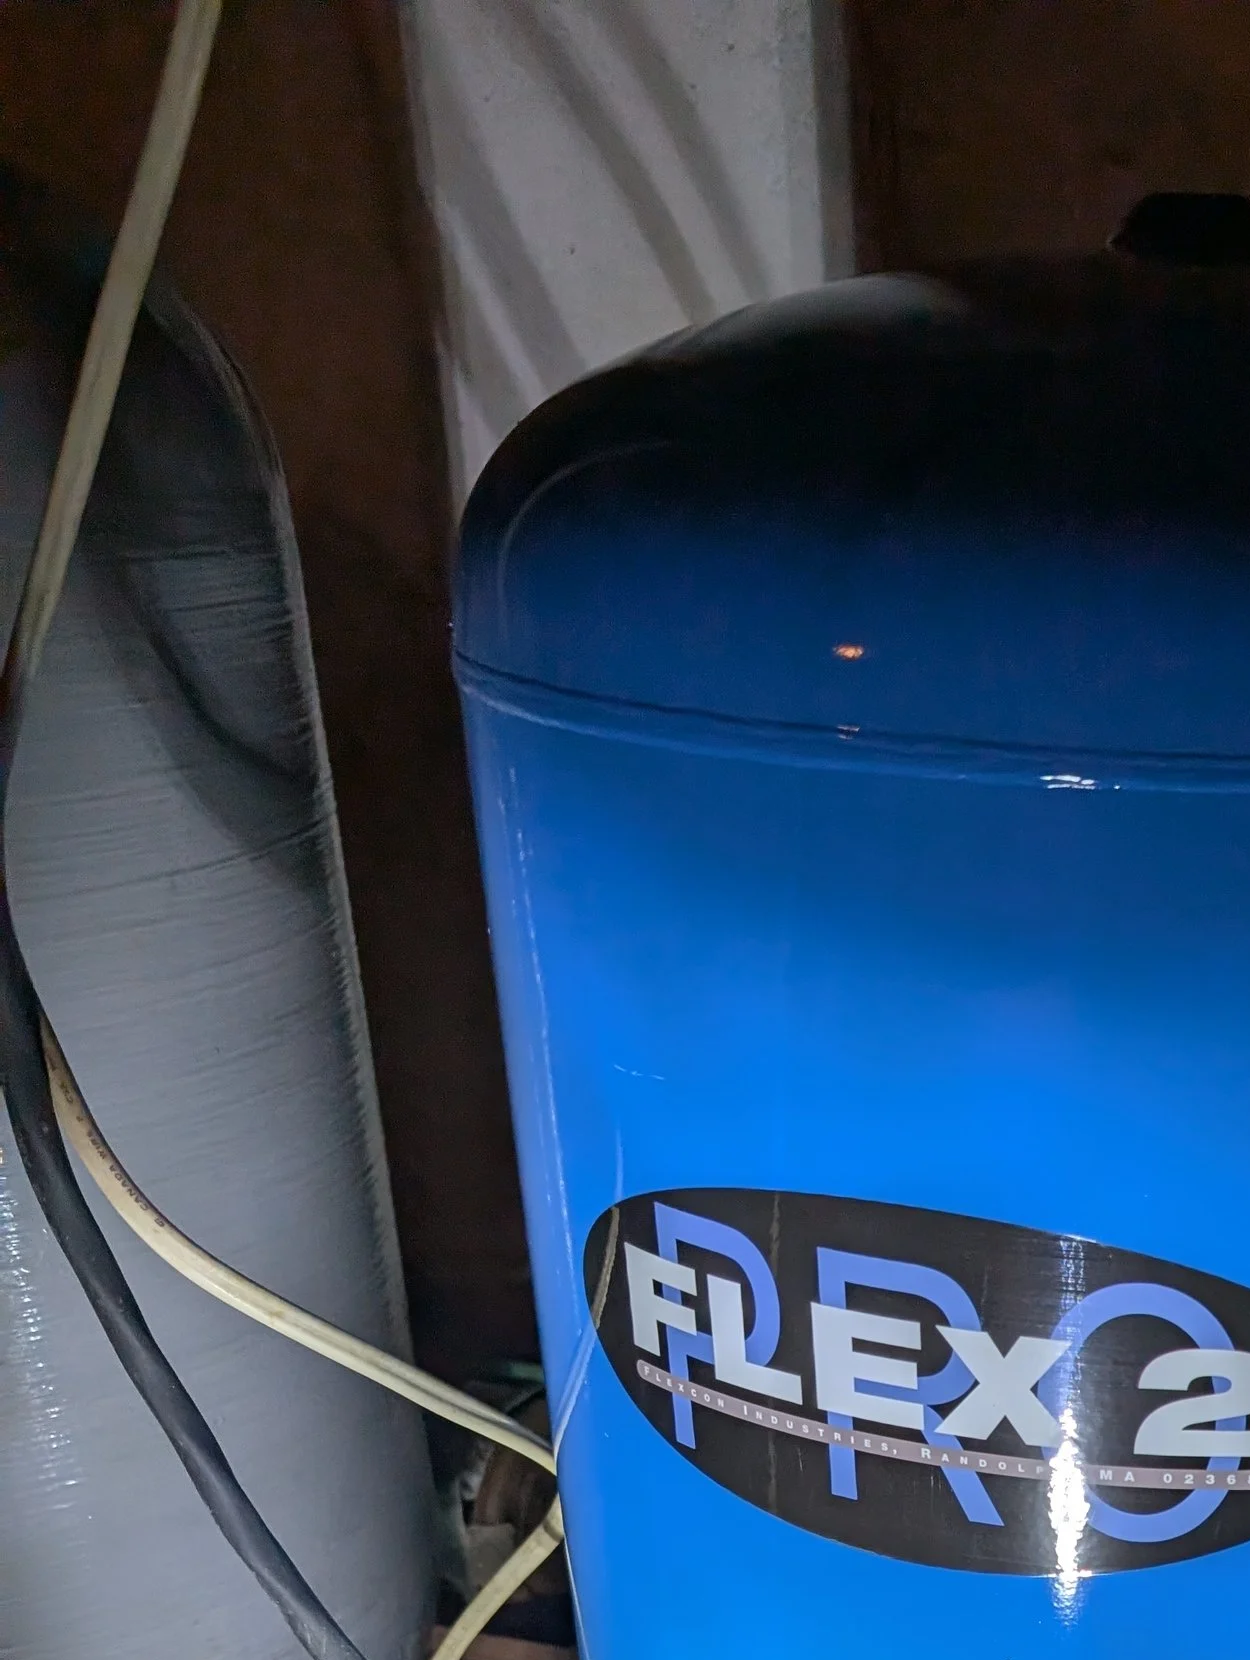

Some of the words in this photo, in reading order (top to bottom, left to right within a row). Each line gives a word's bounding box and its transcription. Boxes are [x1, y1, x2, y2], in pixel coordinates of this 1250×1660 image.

[624, 1243, 1074, 1446] FLEX
[643, 1365, 724, 1408] FLEXCON
[743, 1405, 898, 1455] INDUSTRIES,
[921, 1447, 1050, 1474] RANDOLP
[1100, 1470, 1135, 1482] MA
